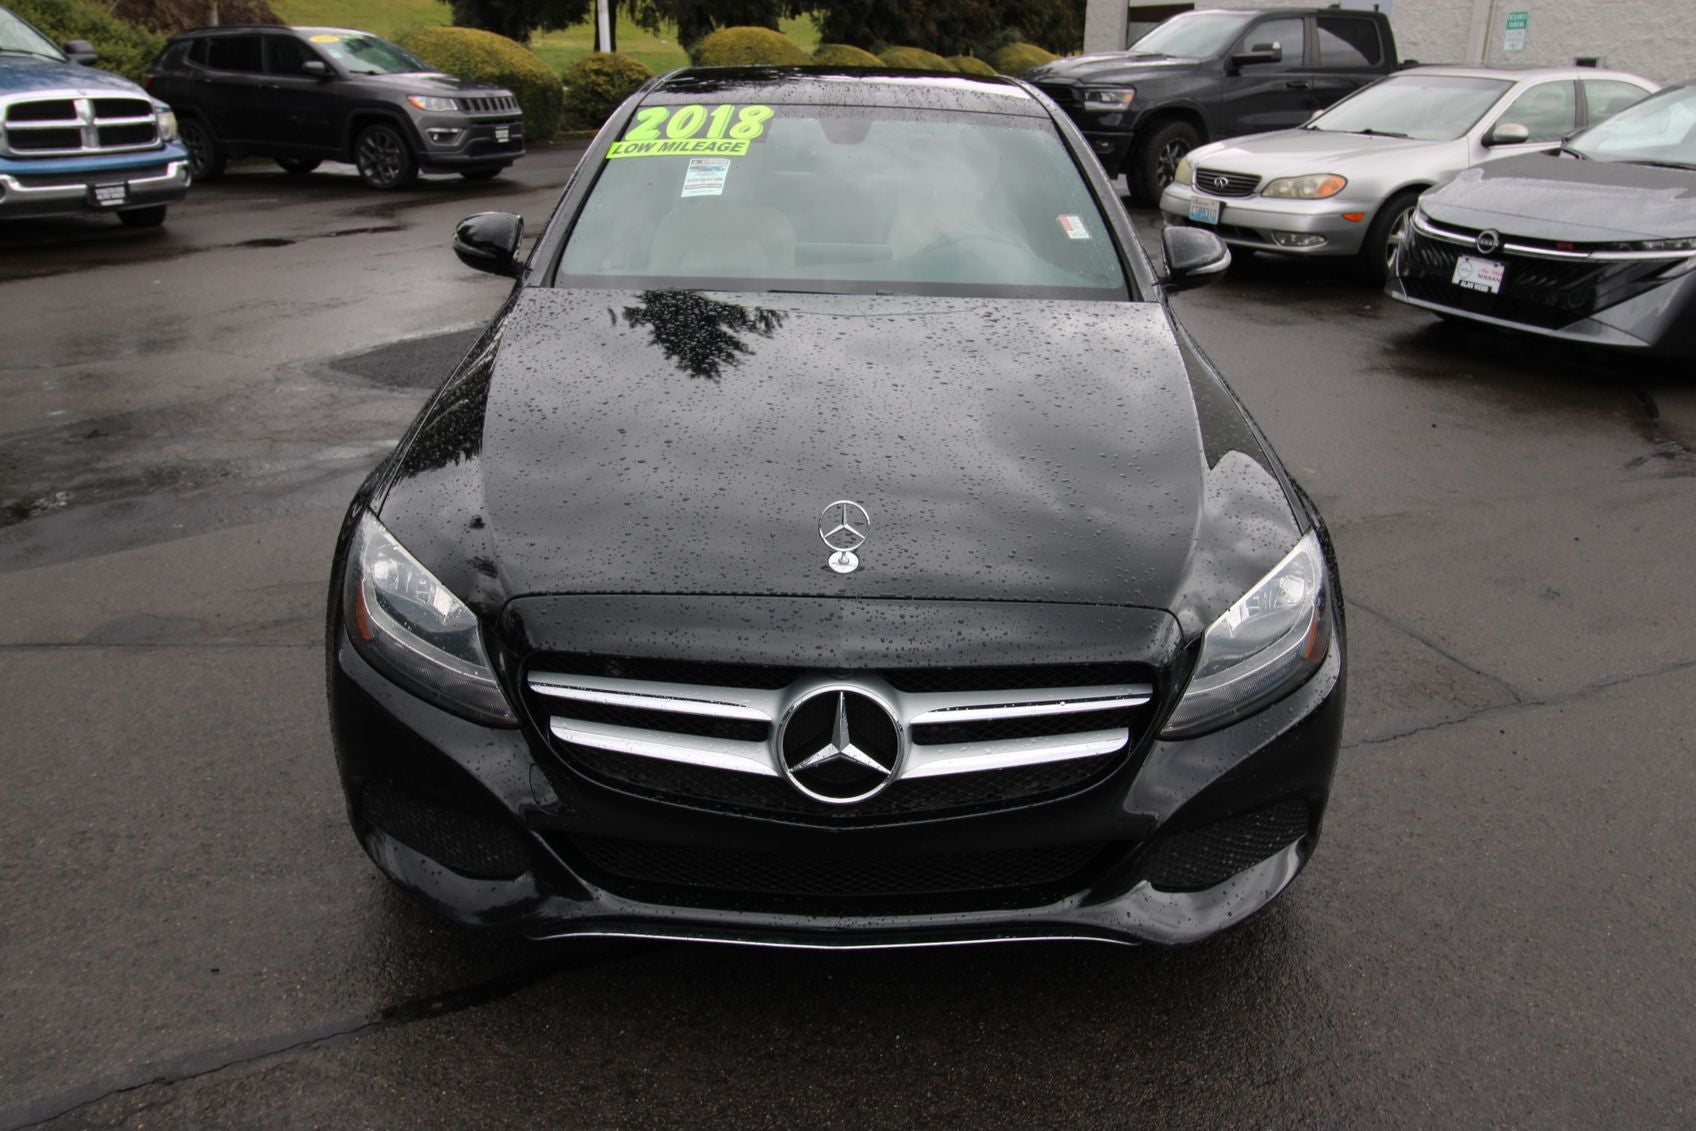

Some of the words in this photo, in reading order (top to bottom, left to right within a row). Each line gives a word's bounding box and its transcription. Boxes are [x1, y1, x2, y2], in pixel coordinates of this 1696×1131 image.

[625, 104, 774, 140] 2018
[613, 141, 656, 155] LOW
[657, 141, 746, 153] MILEAGE
